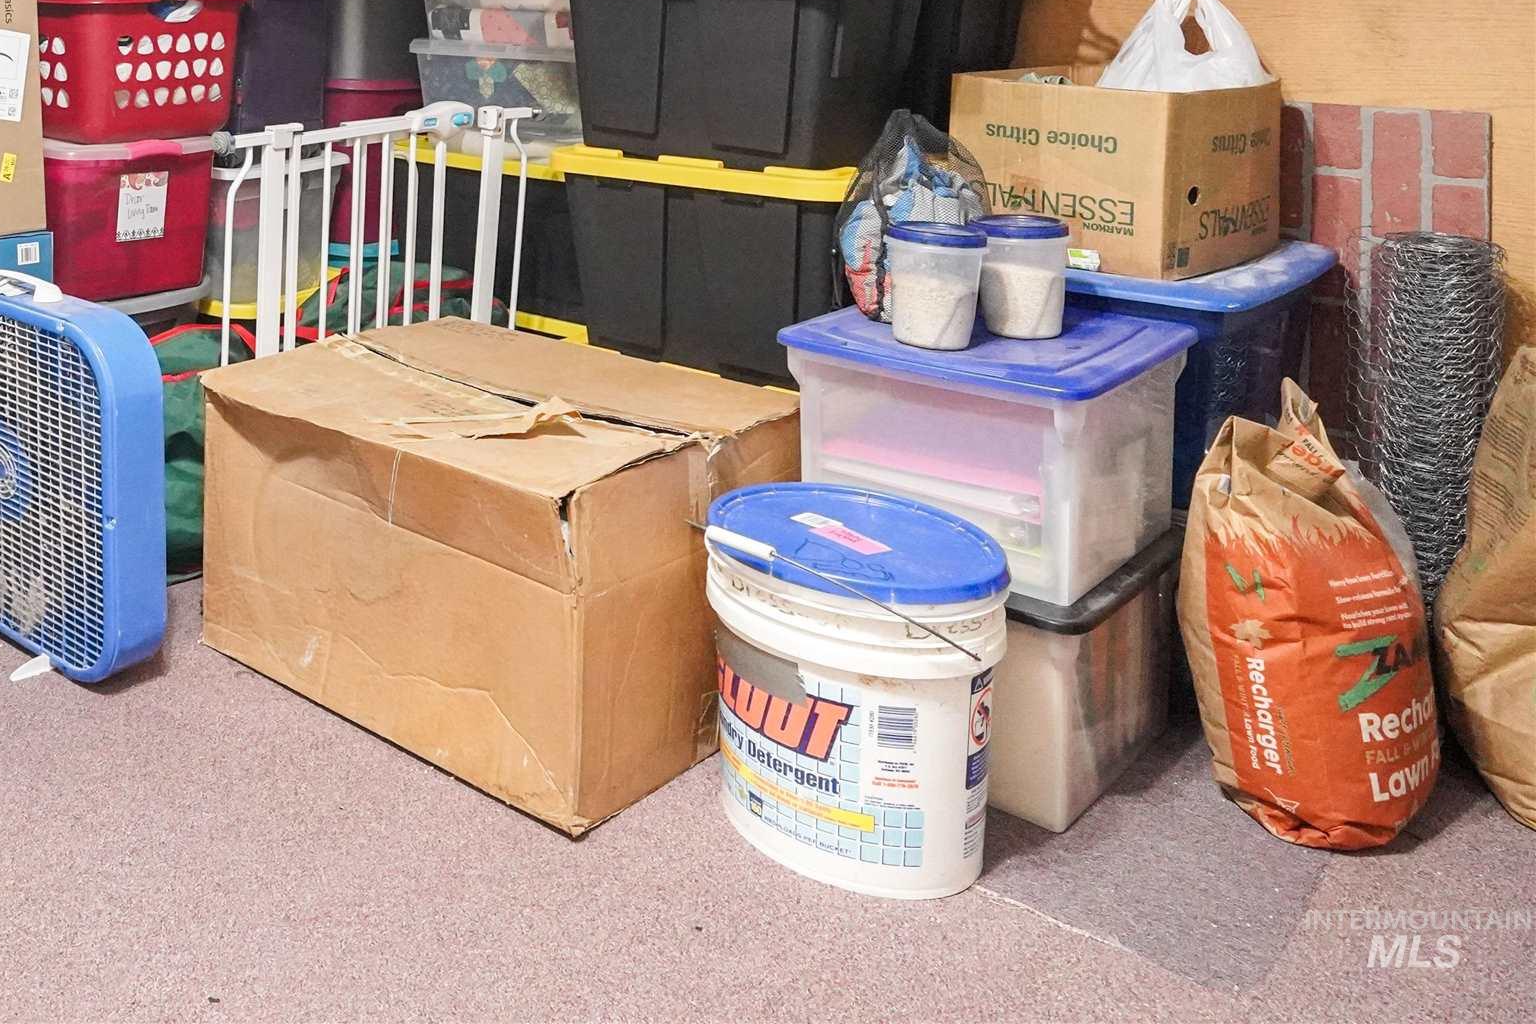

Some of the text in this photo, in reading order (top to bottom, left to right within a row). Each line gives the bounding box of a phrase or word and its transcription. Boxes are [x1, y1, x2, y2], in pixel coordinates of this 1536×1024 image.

[985, 122, 1119, 155] Choice Citrus
[1210, 129, 1248, 156] Citrus
[1082, 222, 1136, 238] MARKON
[1246, 657, 1284, 776] Recharger
[1358, 687, 1436, 744] Recha
[1244, 718, 1256, 745] Lawn
[747, 737, 841, 795] Detergent
[1249, 745, 1262, 770] Food
[1364, 745, 1400, 766] FALL
[1368, 754, 1430, 804] Lawn
[818, 841, 851, 856] BUCKET
